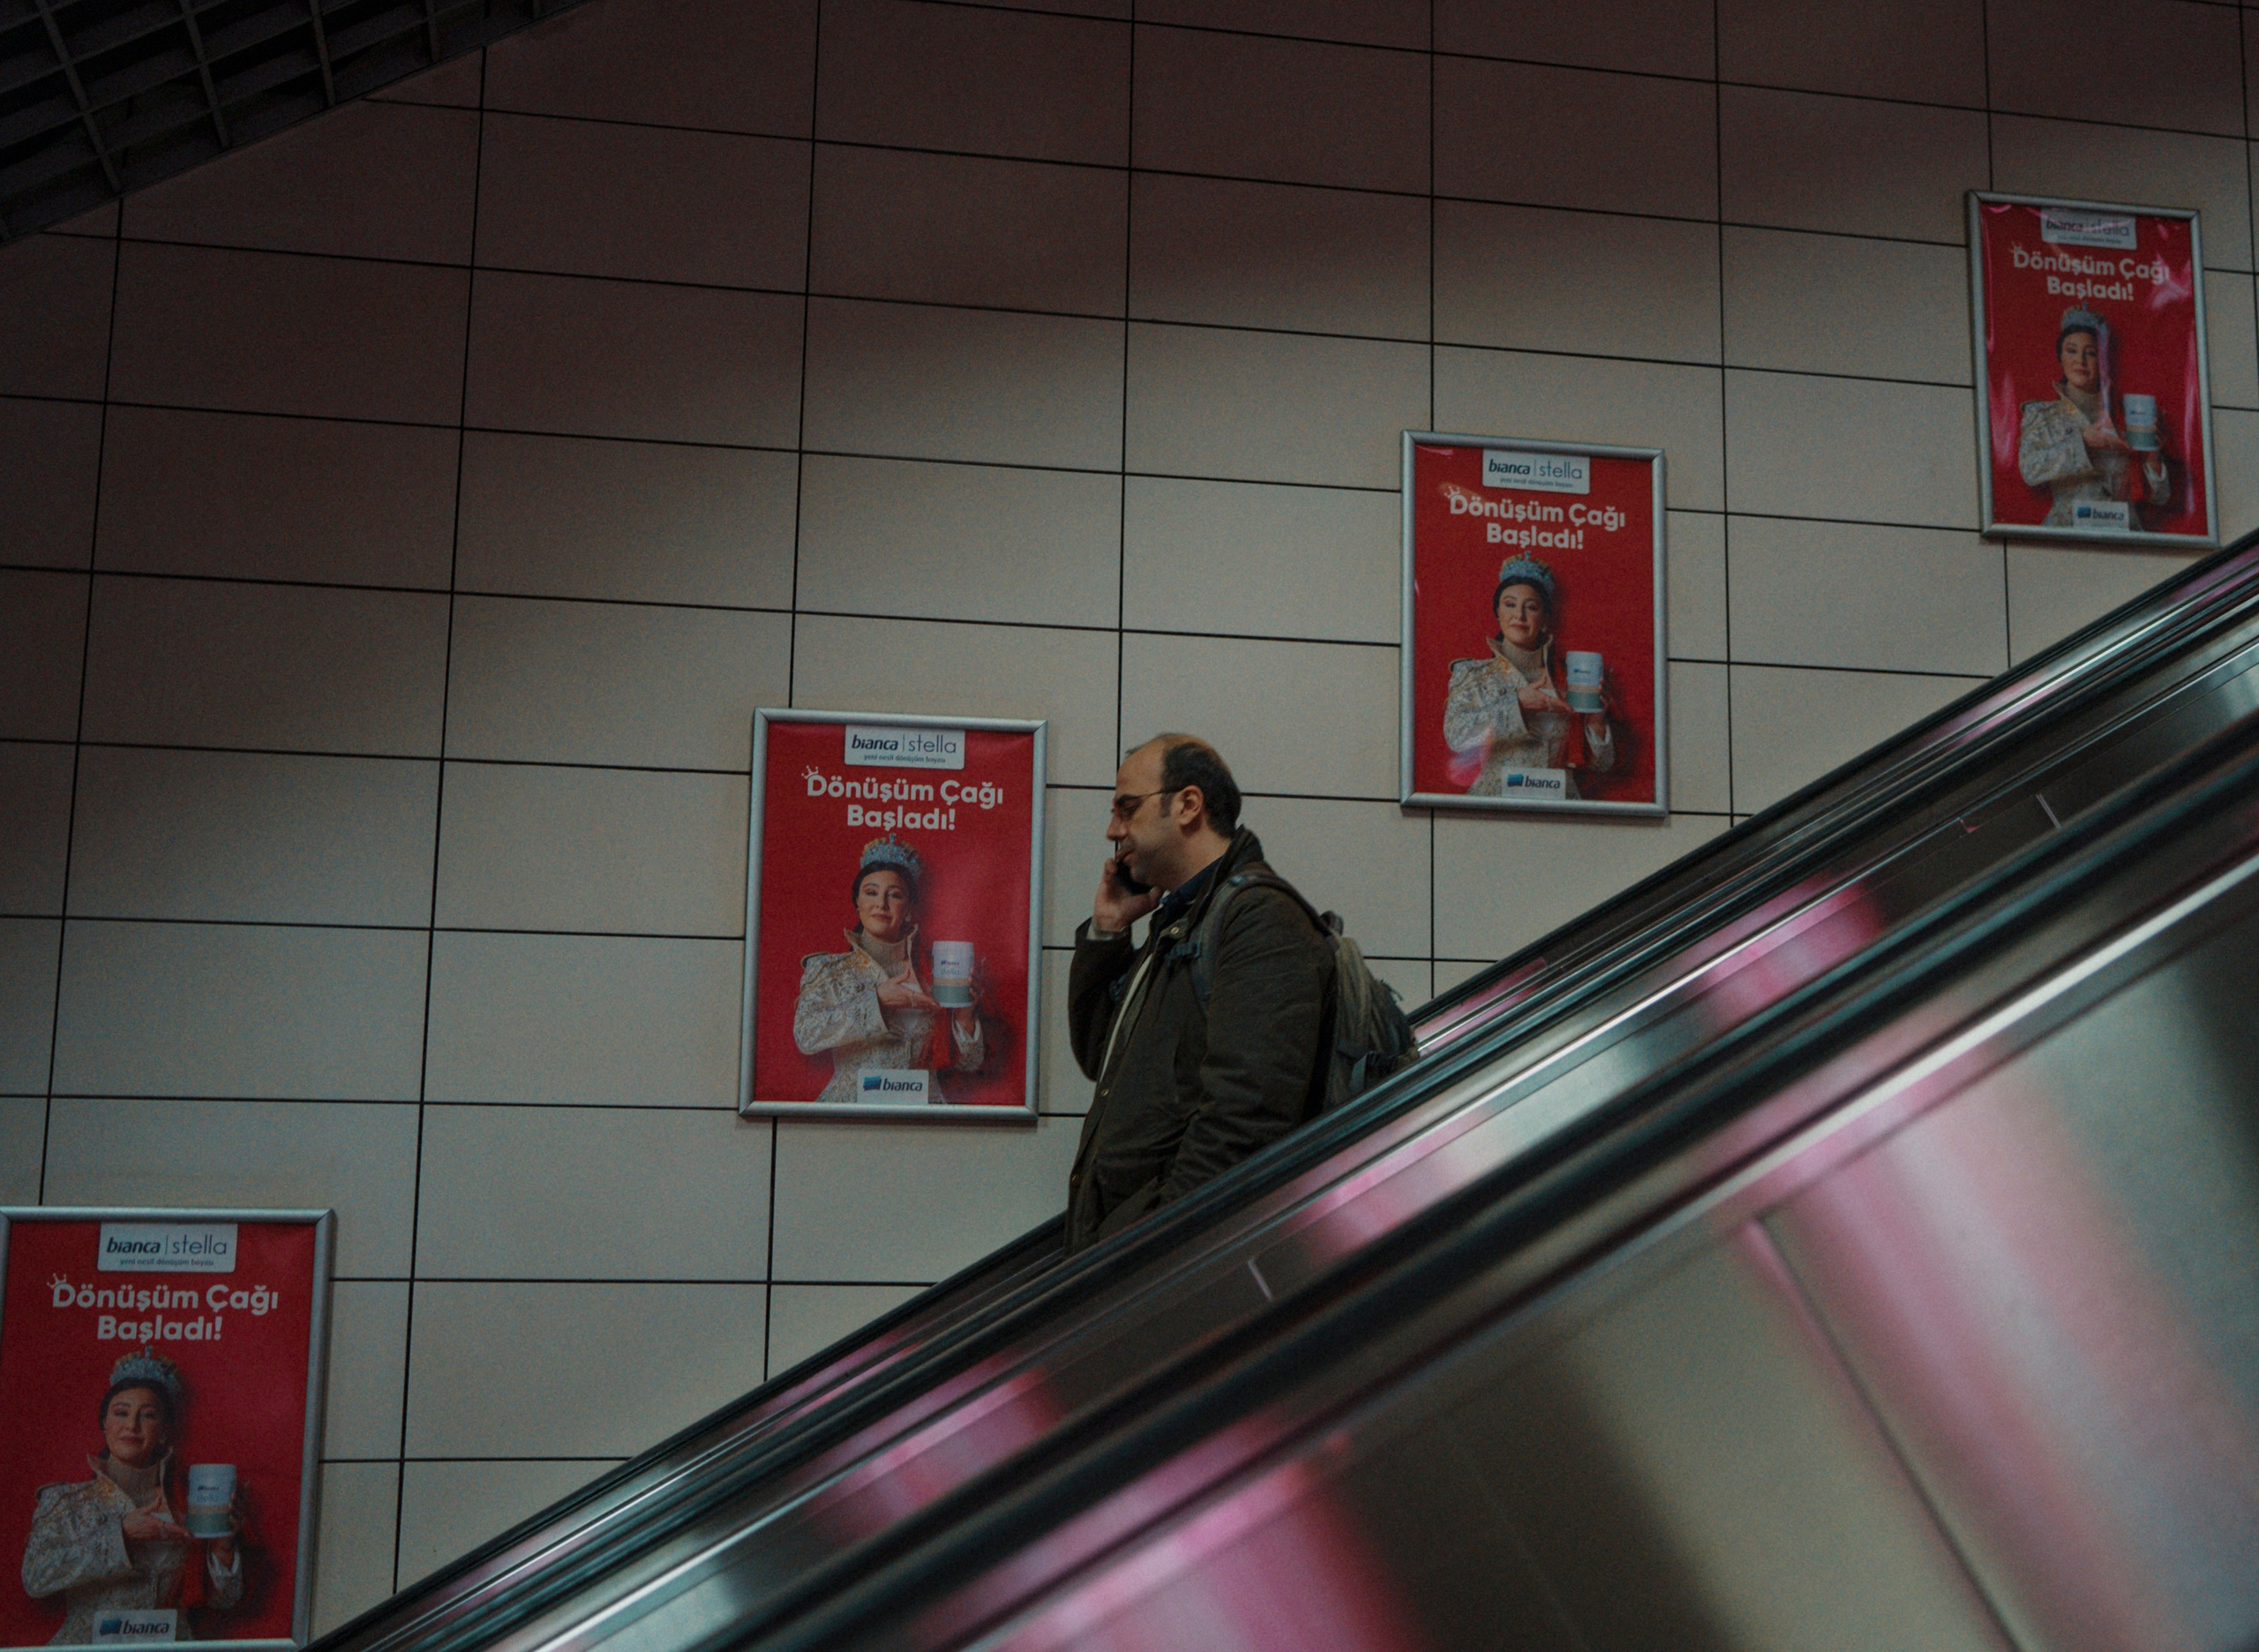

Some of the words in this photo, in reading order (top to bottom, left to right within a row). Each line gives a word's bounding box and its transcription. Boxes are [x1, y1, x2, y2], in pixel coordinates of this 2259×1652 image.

[2013, 250, 2114, 275] Dönüşüm
[2119, 258, 2170, 284] Çağı
[2046, 276, 2134, 301] Başladı!
[1489, 459, 1530, 476] bianca
[1539, 461, 1582, 479] stella
[1450, 494, 1564, 522] Dönüşüm
[1568, 503, 1625, 531] Çağı
[1486, 522, 1584, 549] Başladı!
[852, 734, 898, 751] bianca
[908, 734, 957, 754] stella
[807, 774, 934, 803] Dönüşüm
[940, 779, 1003, 809] Çağı
[1524, 776, 1560, 789] bianca
[847, 804, 956, 831] Başladı!
[882, 1078, 923, 1092] bianca
[106, 1236, 161, 1254] bianca
[172, 1234, 227, 1254] stella
[52, 1283, 199, 1312] Dönüşüm
[206, 1283, 279, 1317] Çağı
[97, 1314, 222, 1344] Başladı!
[121, 1618, 169, 1634] bianca
